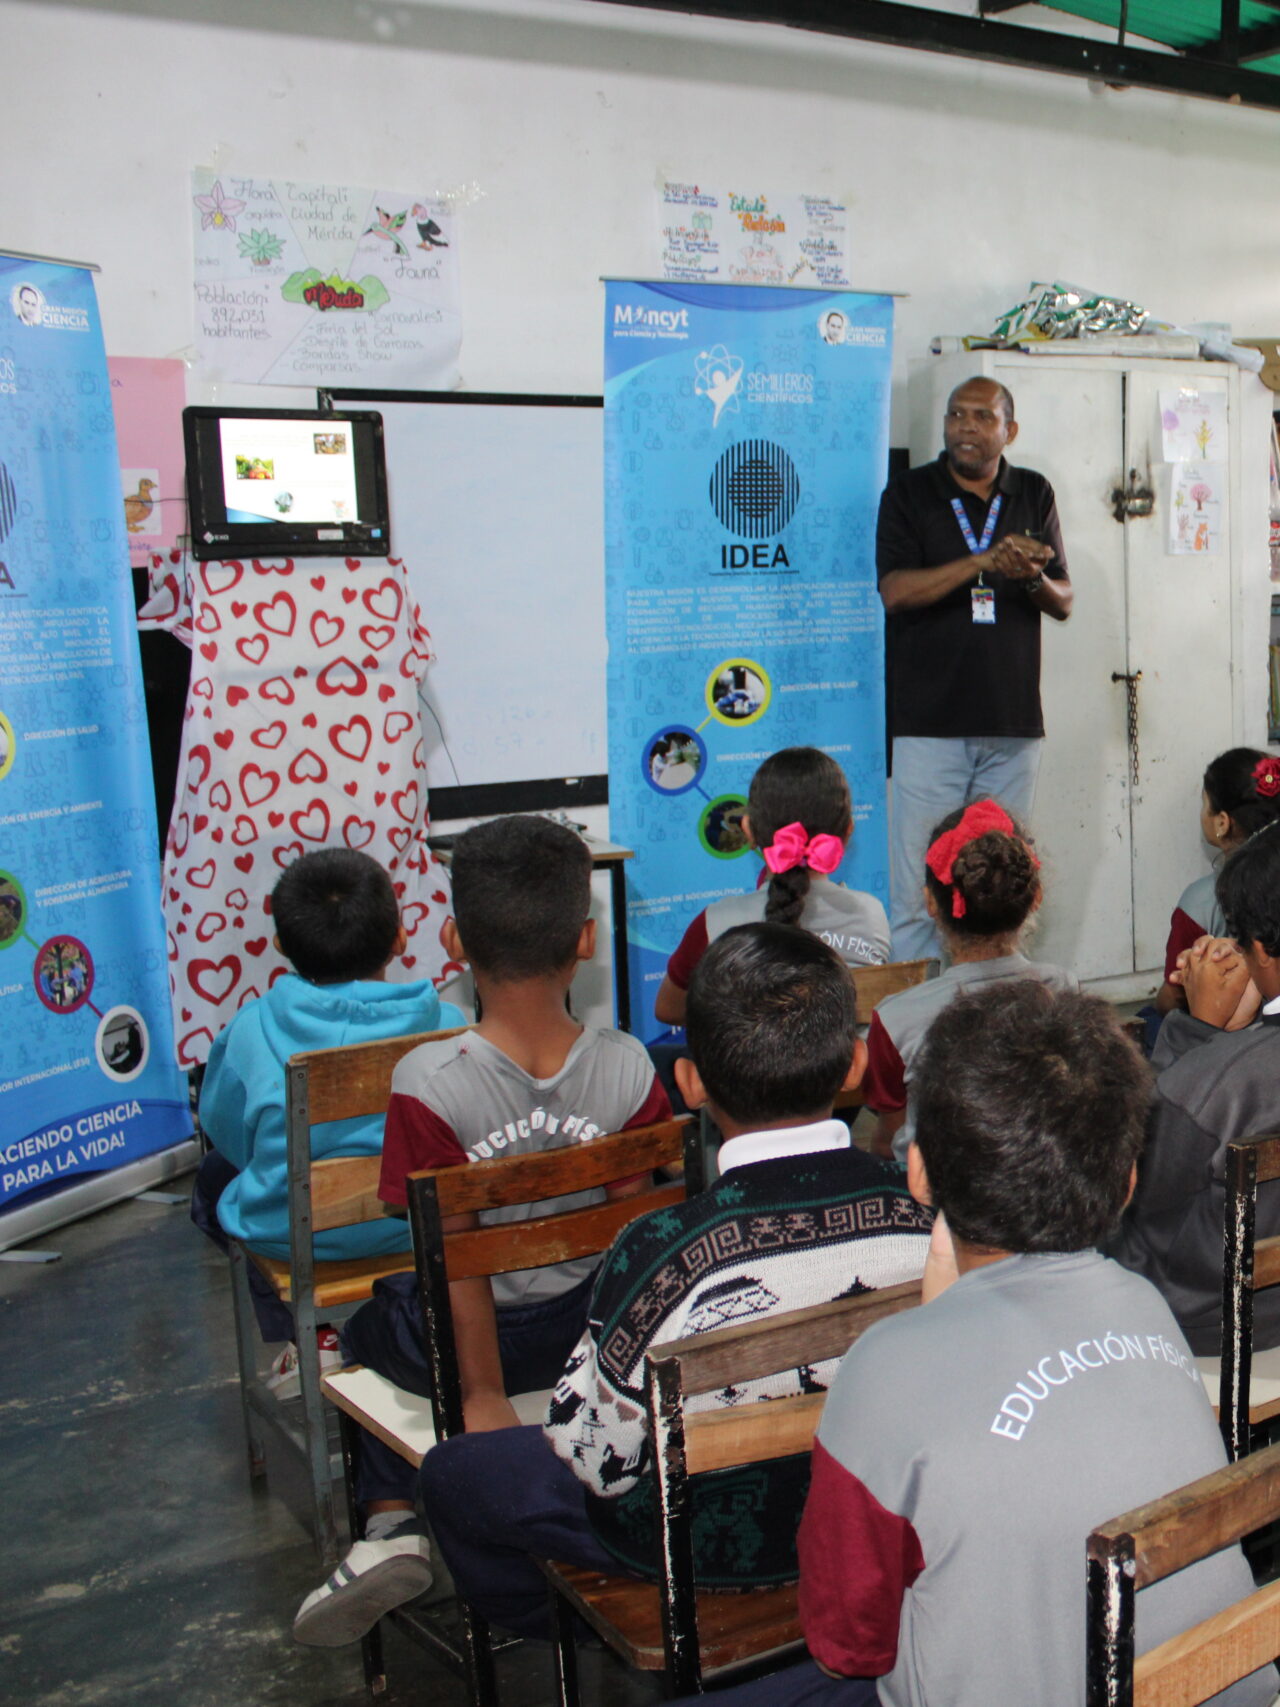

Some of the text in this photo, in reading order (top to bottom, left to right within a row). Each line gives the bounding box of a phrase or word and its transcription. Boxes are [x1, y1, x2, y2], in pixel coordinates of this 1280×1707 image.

[41, 312, 90, 328] CIENCIA
[721, 543, 790, 569] IDEA
[24, 728, 67, 741] DIRECCIÓN
[35, 881, 76, 898] DIRECCIÓN
[77, 1100, 143, 1137] CIENCIA
[3, 1131, 125, 1192] PARA LA VIDA!
[990, 1331, 1147, 1440] EDUCACIÓN
